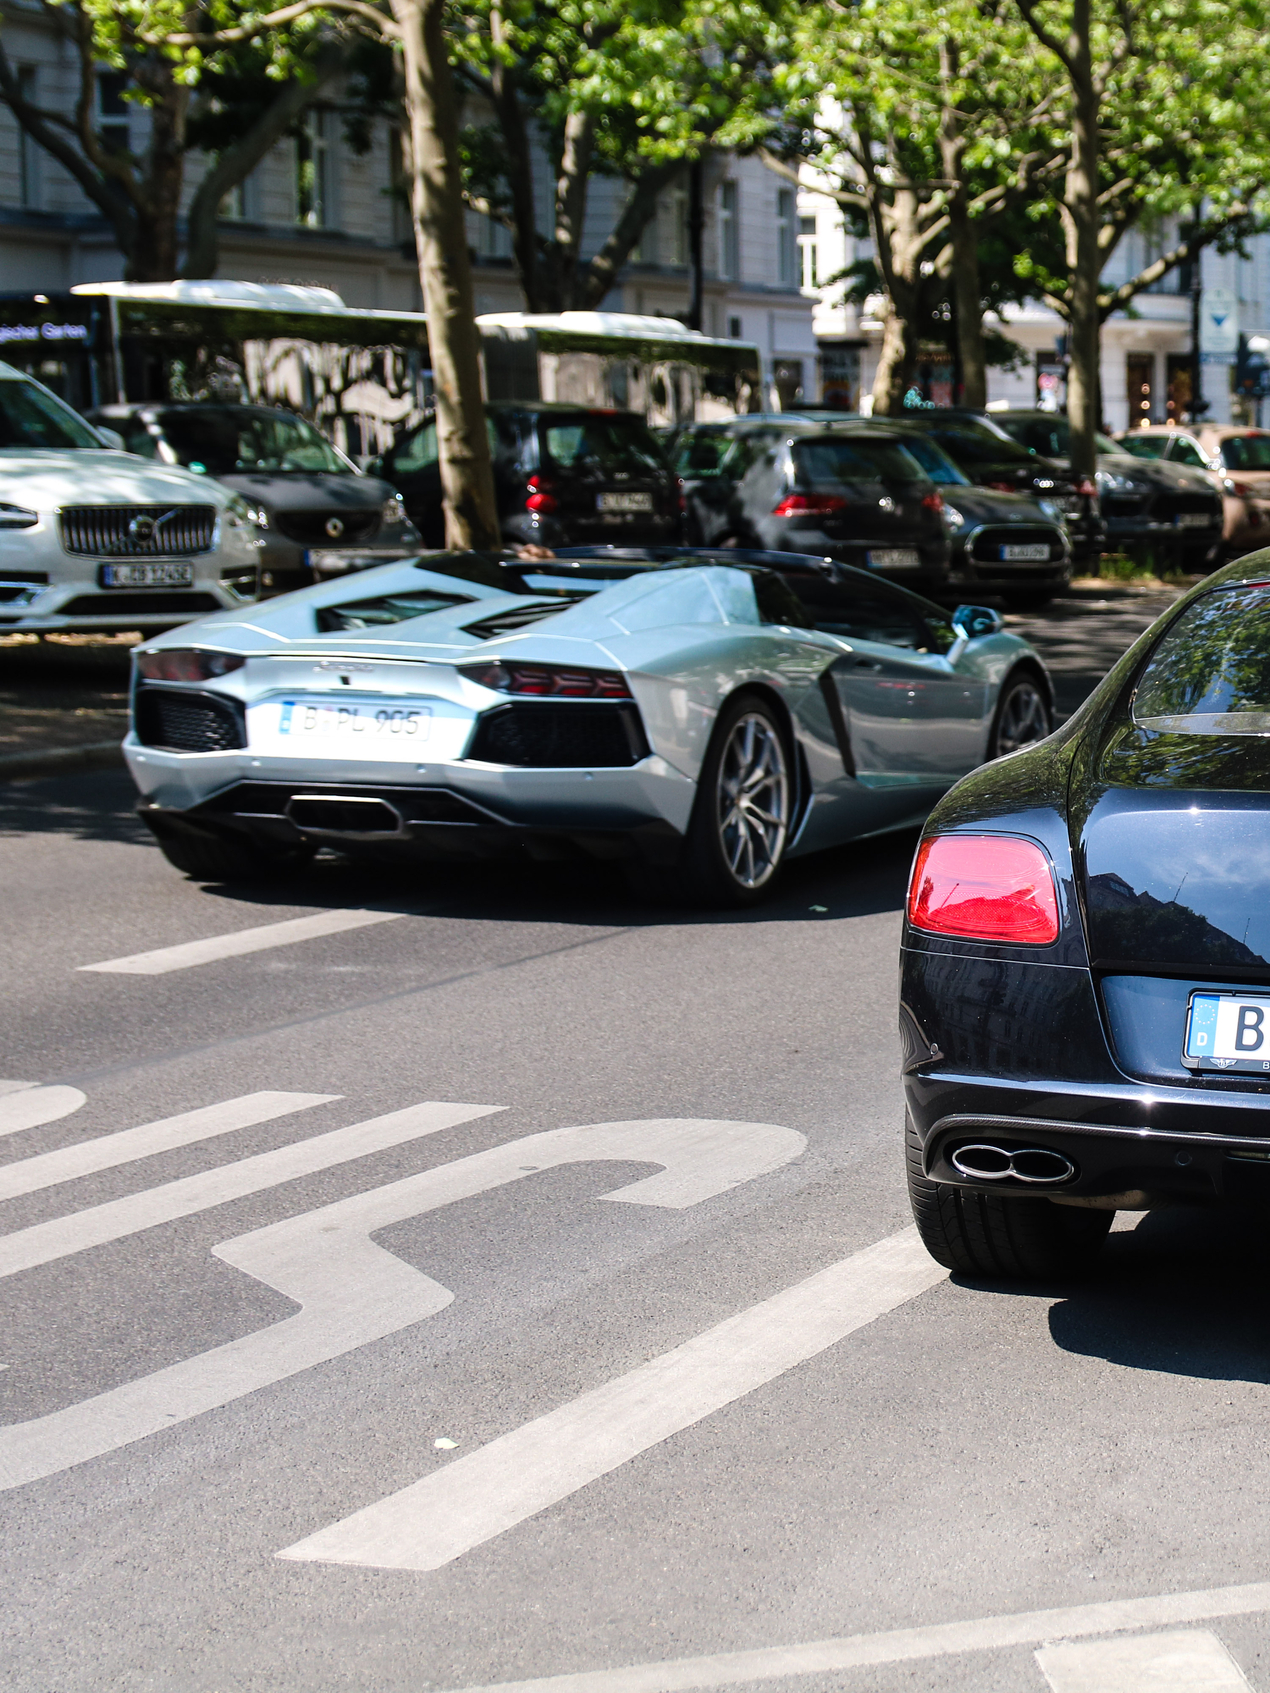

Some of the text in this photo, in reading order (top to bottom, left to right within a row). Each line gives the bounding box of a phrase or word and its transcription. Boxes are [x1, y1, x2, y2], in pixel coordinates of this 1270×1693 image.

[41, 322, 88, 340] Garten
[304, 706, 421, 735] B PL 905
[1197, 1033, 1208, 1047] D
[1235, 1005, 1264, 1052] B
